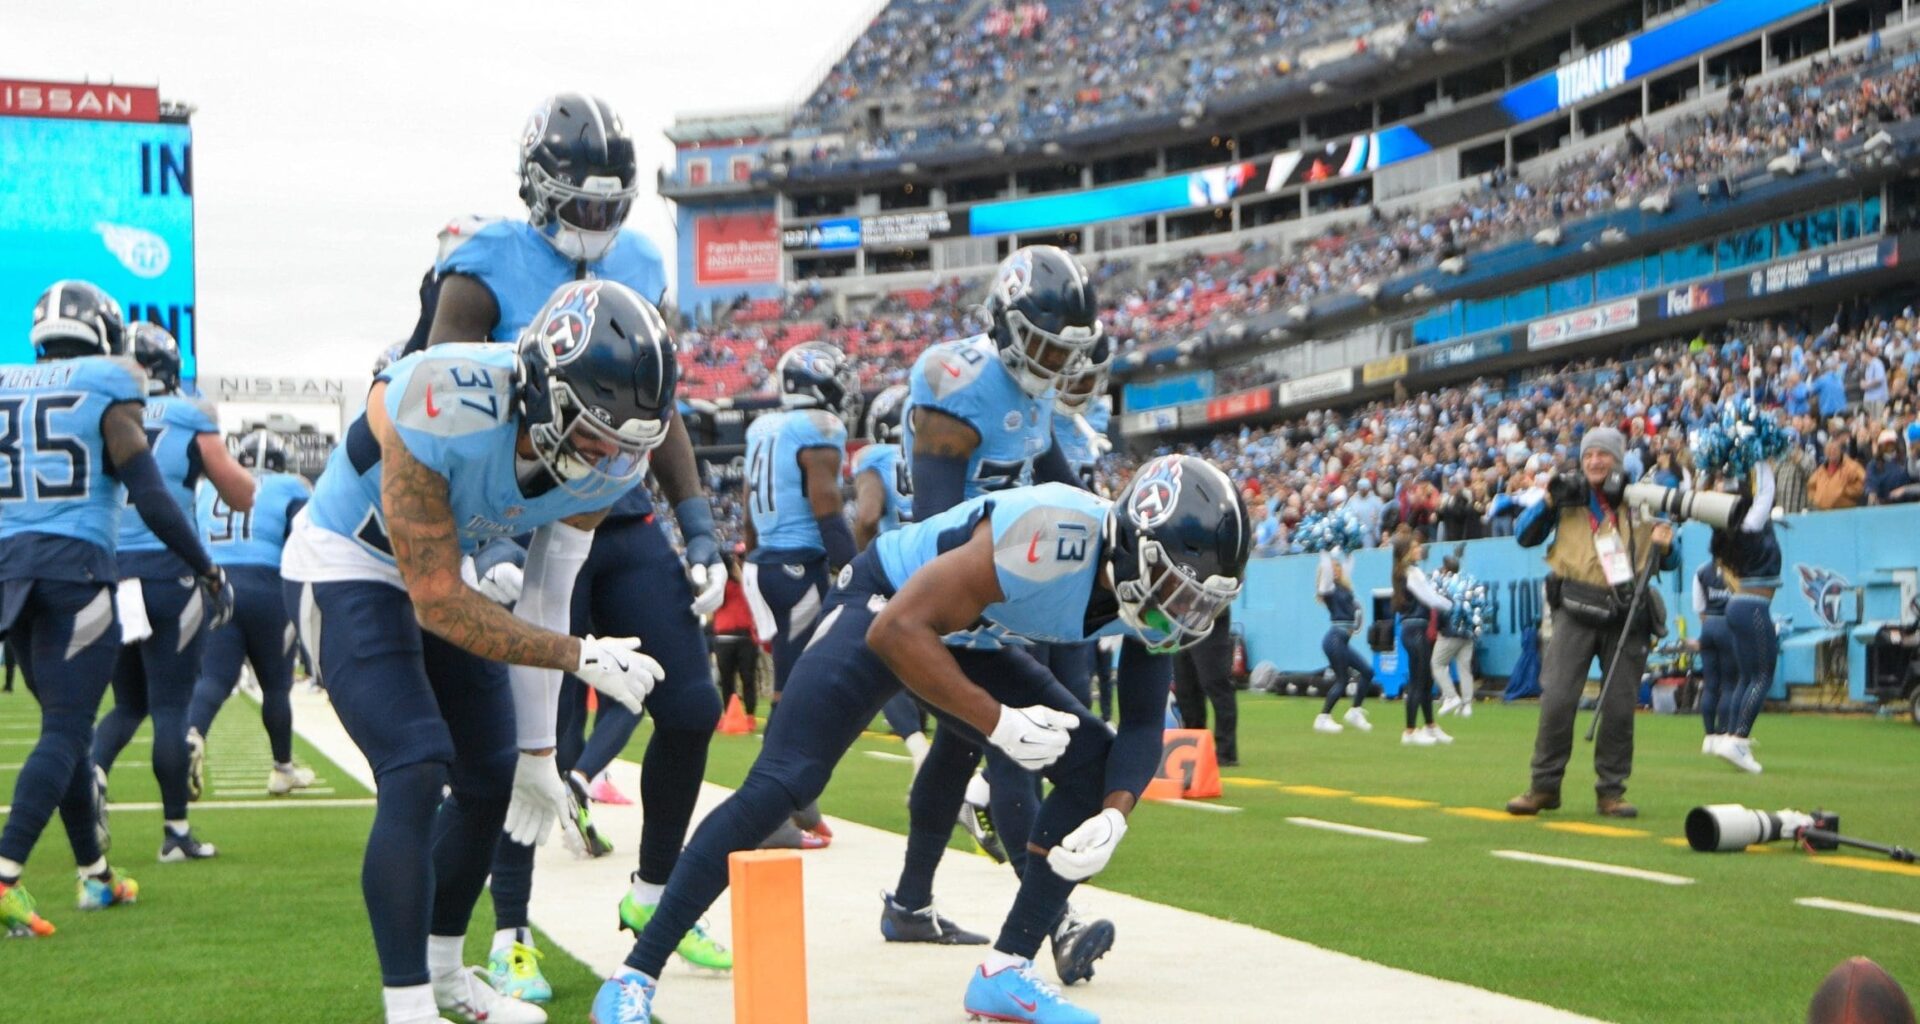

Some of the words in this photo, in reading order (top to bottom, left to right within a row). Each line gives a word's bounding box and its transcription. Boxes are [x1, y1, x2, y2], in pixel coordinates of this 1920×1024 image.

[1556, 48, 1604, 108] TITAN
[1605, 39, 1632, 90] UP
[5, 86, 132, 116] ISSAN
[1667, 284, 1710, 318] FedEx
[219, 377, 343, 393] NISSAN
[450, 366, 498, 420] 37
[749, 435, 777, 517] 41
[1057, 523, 1087, 562] 13
[1153, 737, 1198, 790] G
